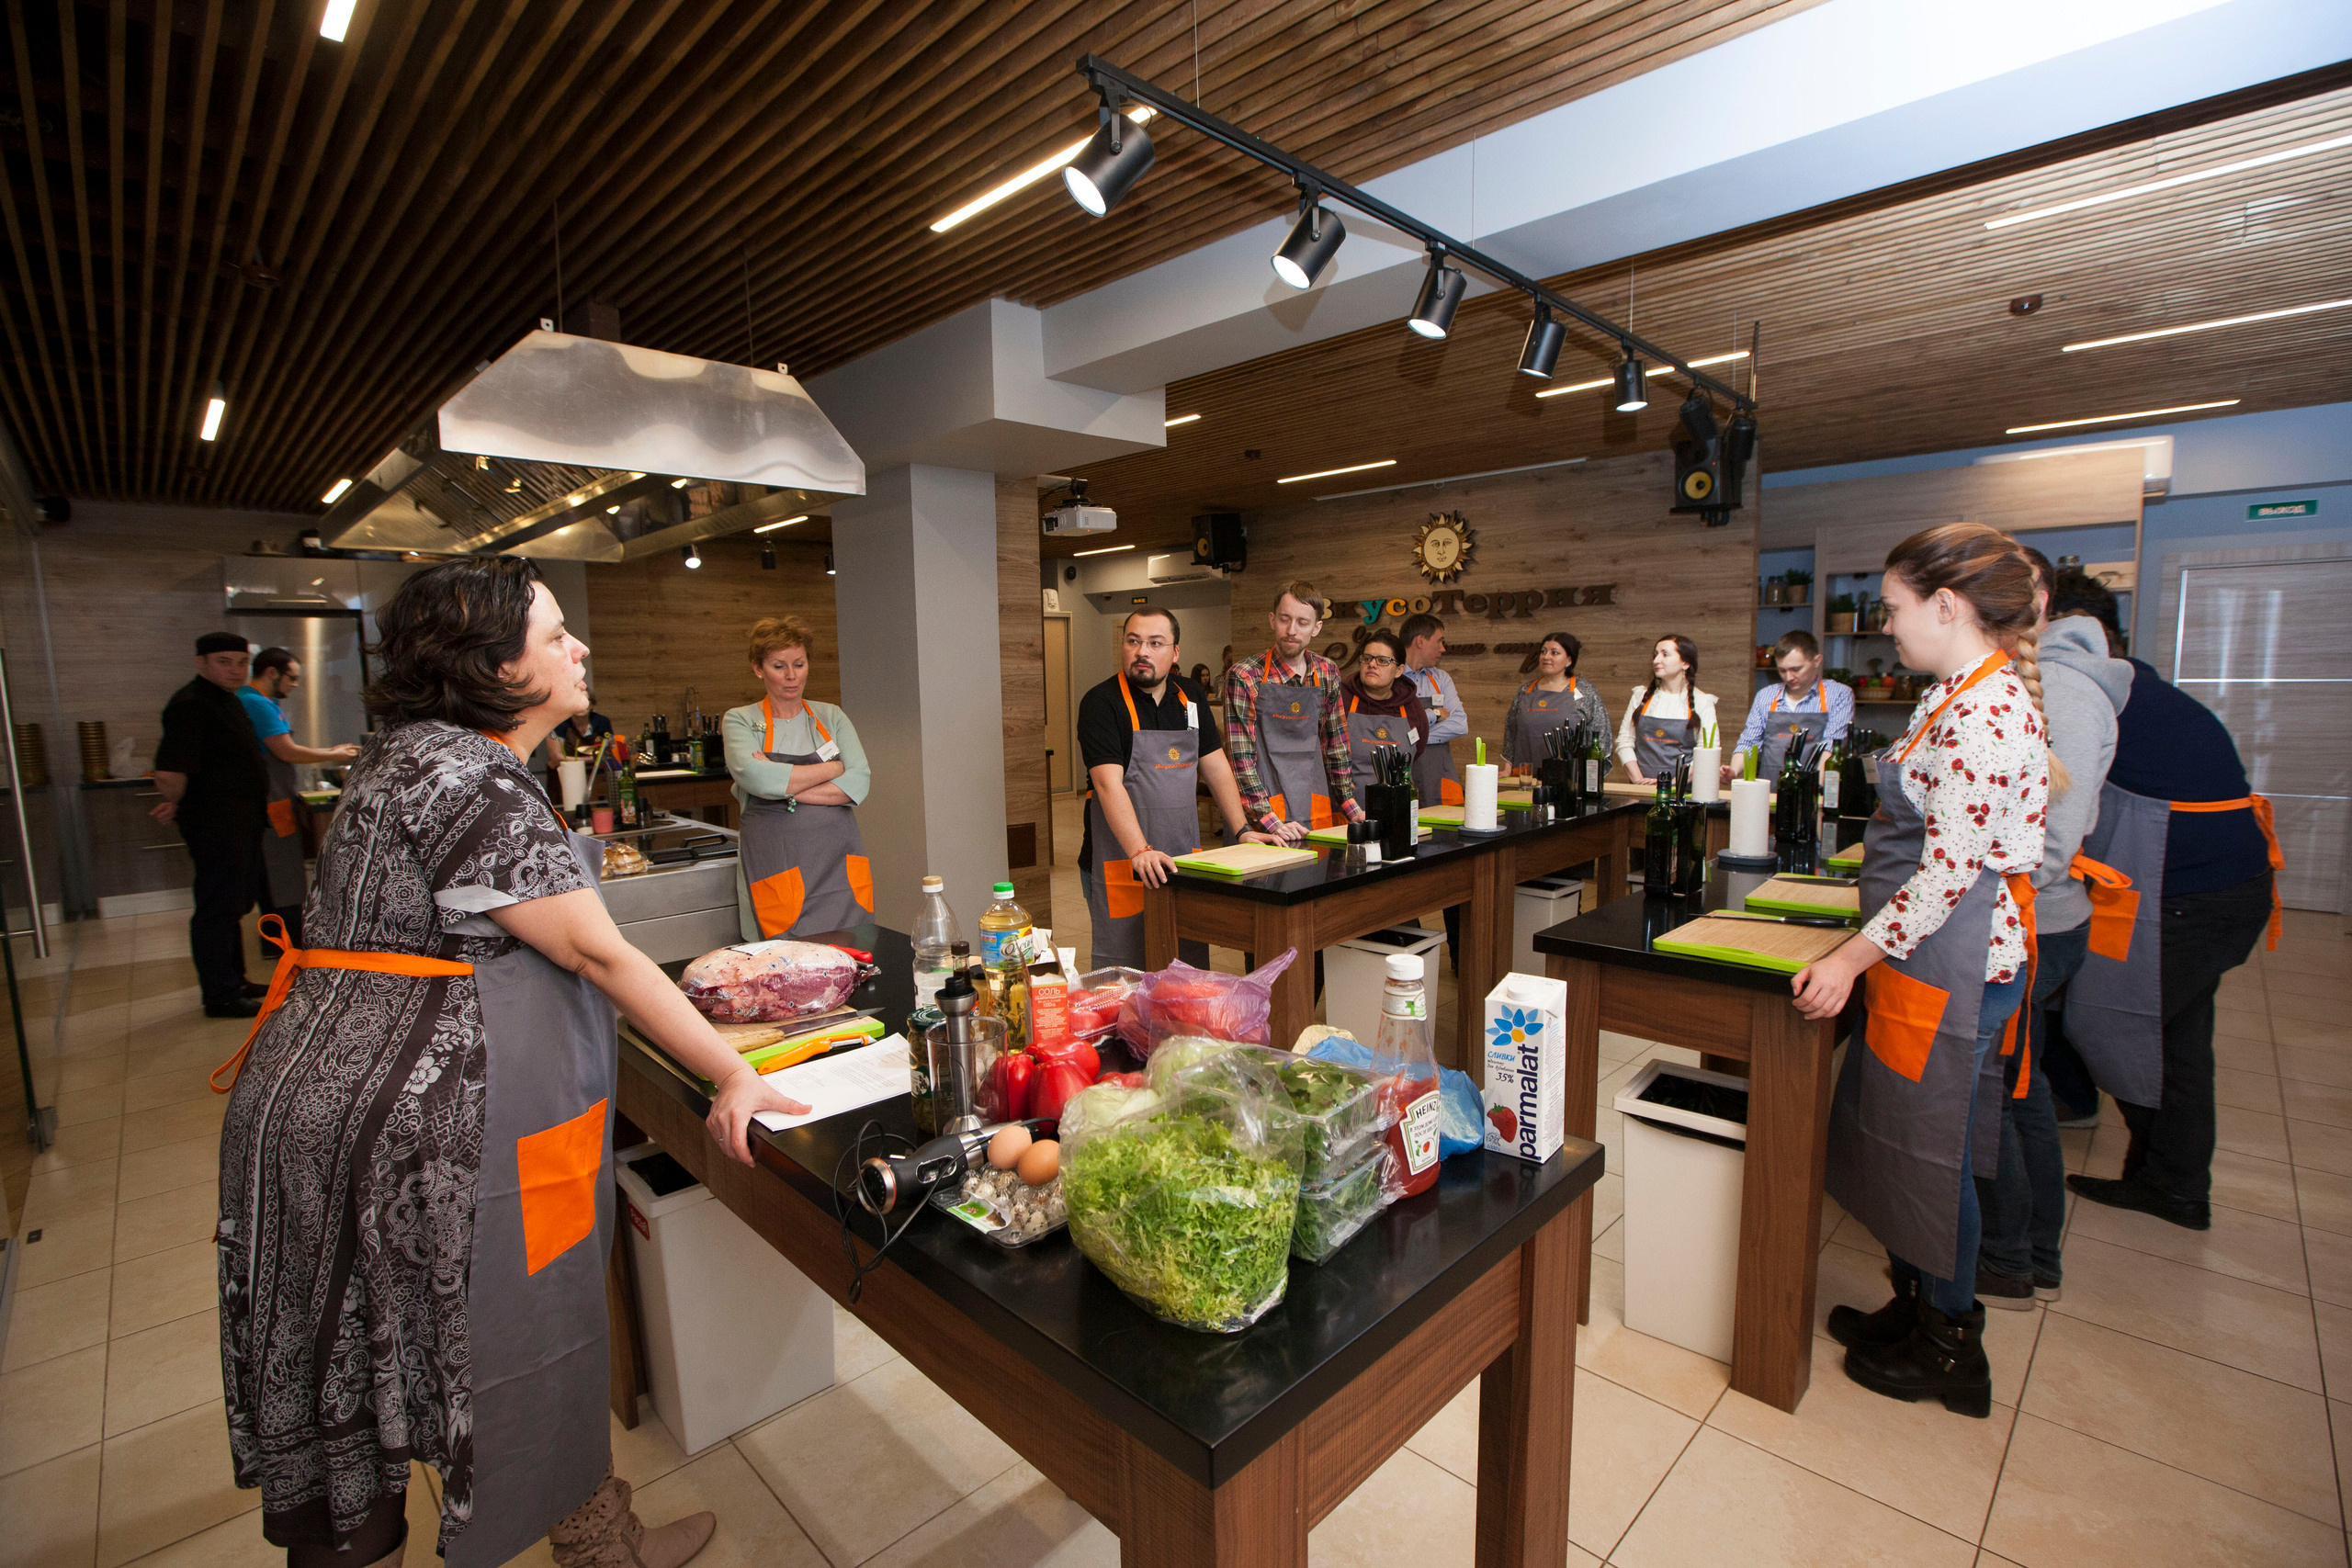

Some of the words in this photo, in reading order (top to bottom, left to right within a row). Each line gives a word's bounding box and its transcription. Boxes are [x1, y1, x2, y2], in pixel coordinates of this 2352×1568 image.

[1038, 987, 1061, 996] СОЛЬ
[1487, 1050, 1516, 1063] СЛИВКИ
[1495, 1072, 1514, 1084] 35%
[1517, 1043, 1542, 1161] parmalat
[1415, 1100, 1437, 1119] HEINZ
